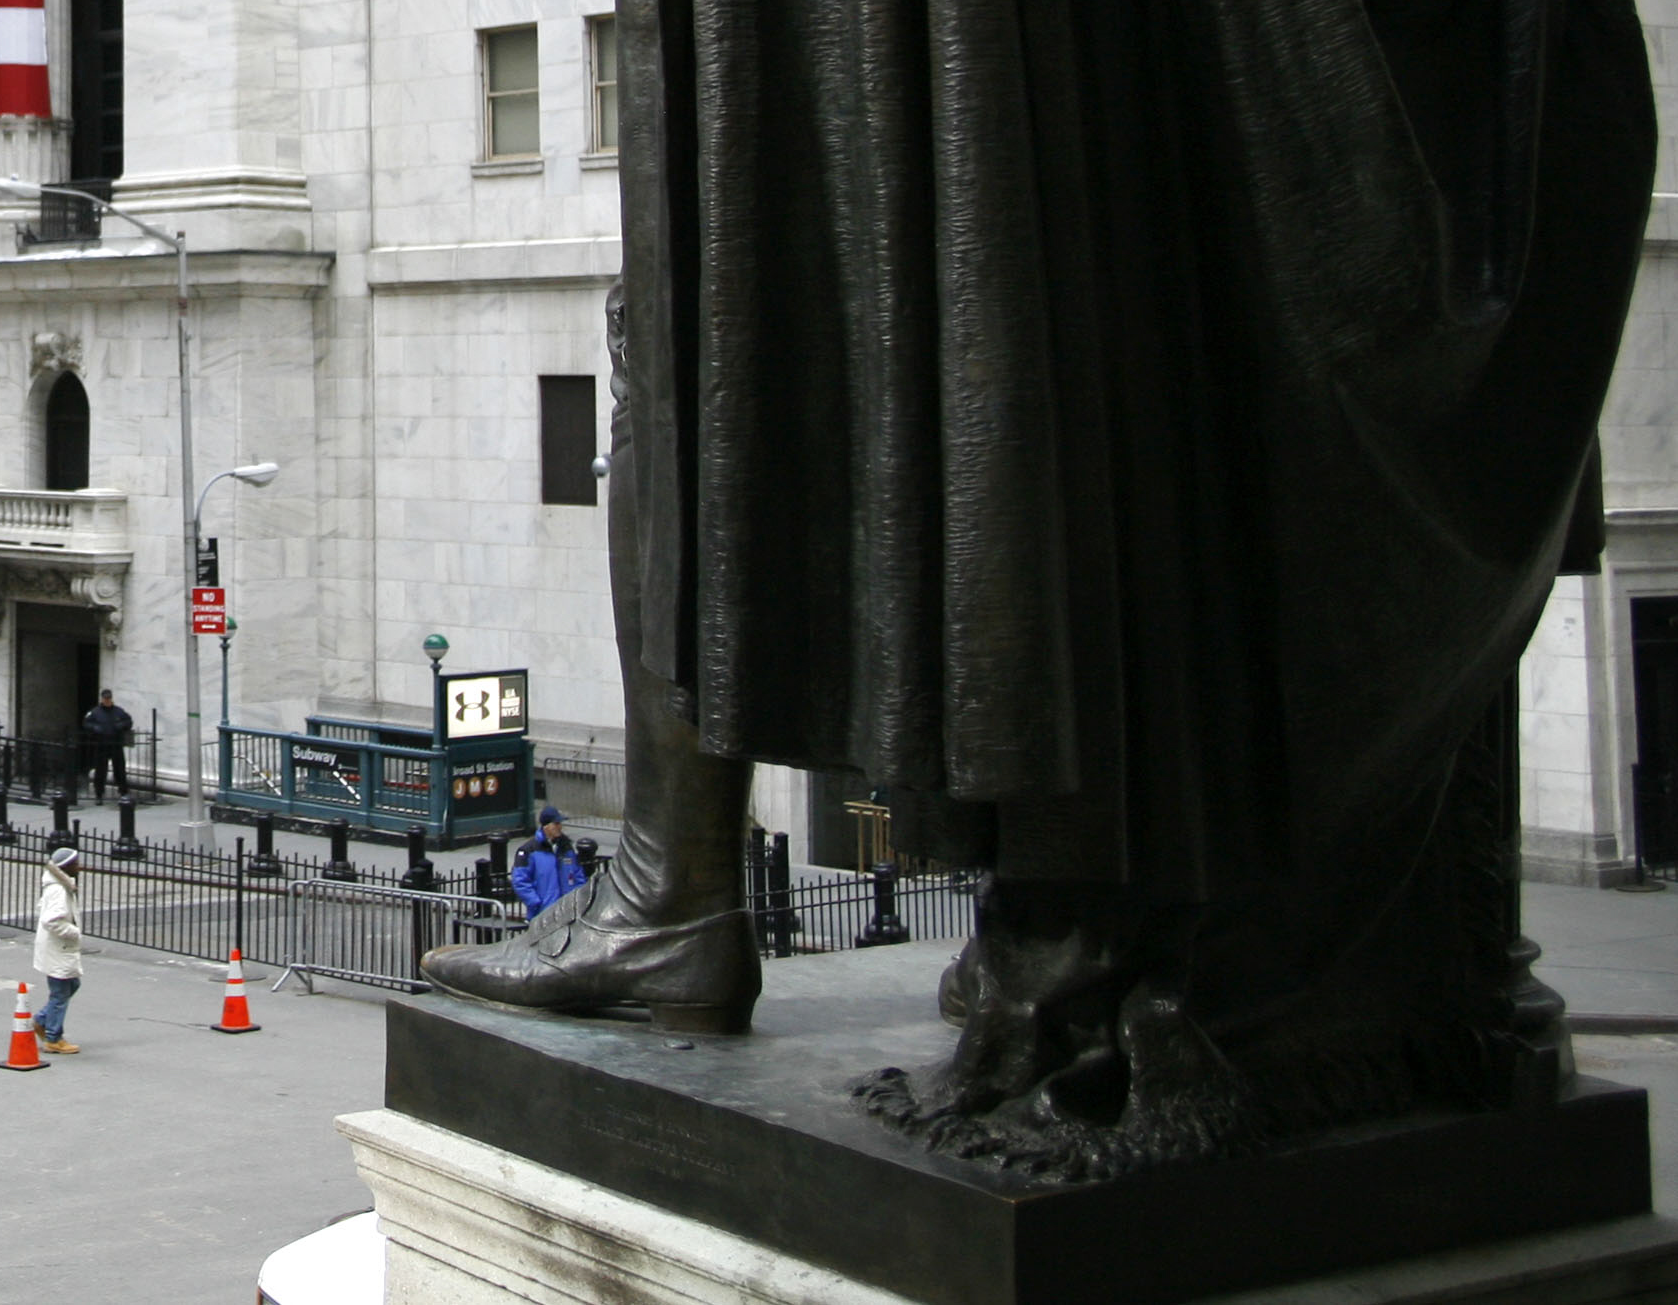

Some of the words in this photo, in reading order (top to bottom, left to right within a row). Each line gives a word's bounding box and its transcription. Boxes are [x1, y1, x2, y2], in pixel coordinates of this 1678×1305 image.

[202, 592, 215, 602] NO
[501, 706, 520, 717] NYSE
[292, 745, 336, 766] Subway
[476, 763, 485, 773] St
[487, 762, 514, 772] Station
